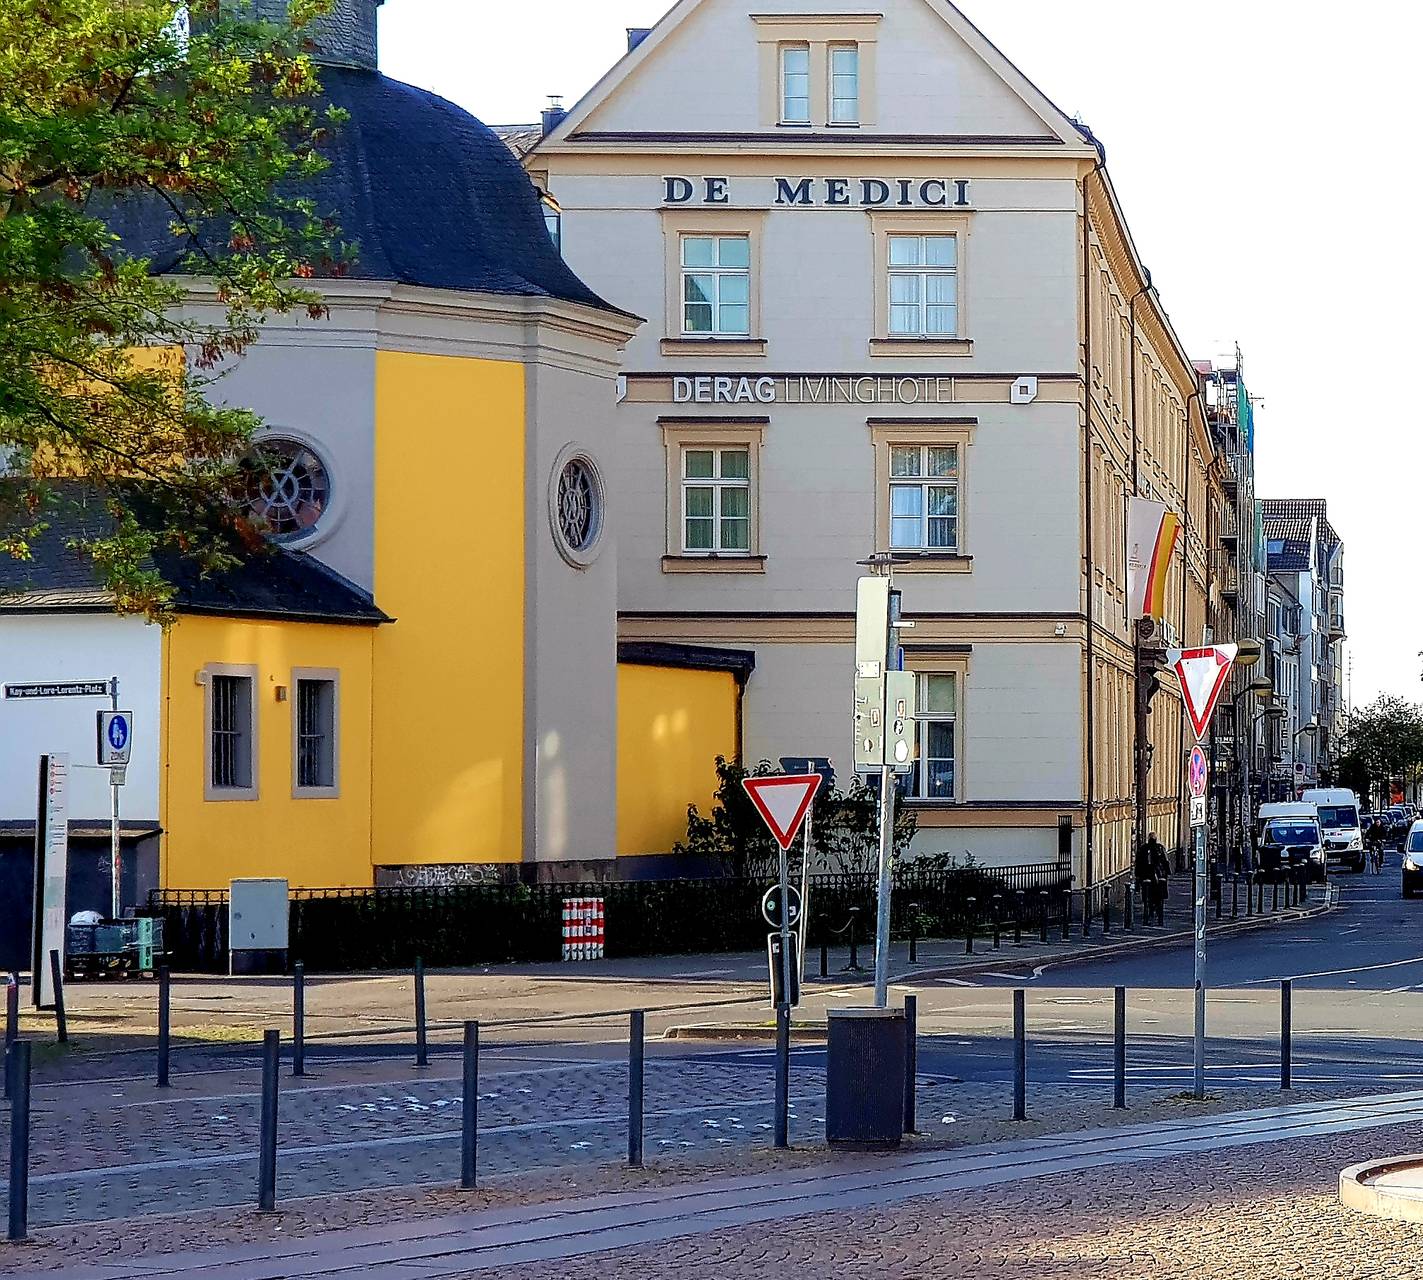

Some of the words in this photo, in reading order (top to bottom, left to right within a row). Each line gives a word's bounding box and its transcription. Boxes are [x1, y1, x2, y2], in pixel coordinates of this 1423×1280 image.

[663, 176, 730, 203] DE
[774, 177, 971, 206] MEDICI
[672, 376, 776, 404] DERAG
[110, 751, 125, 761] ZONE
